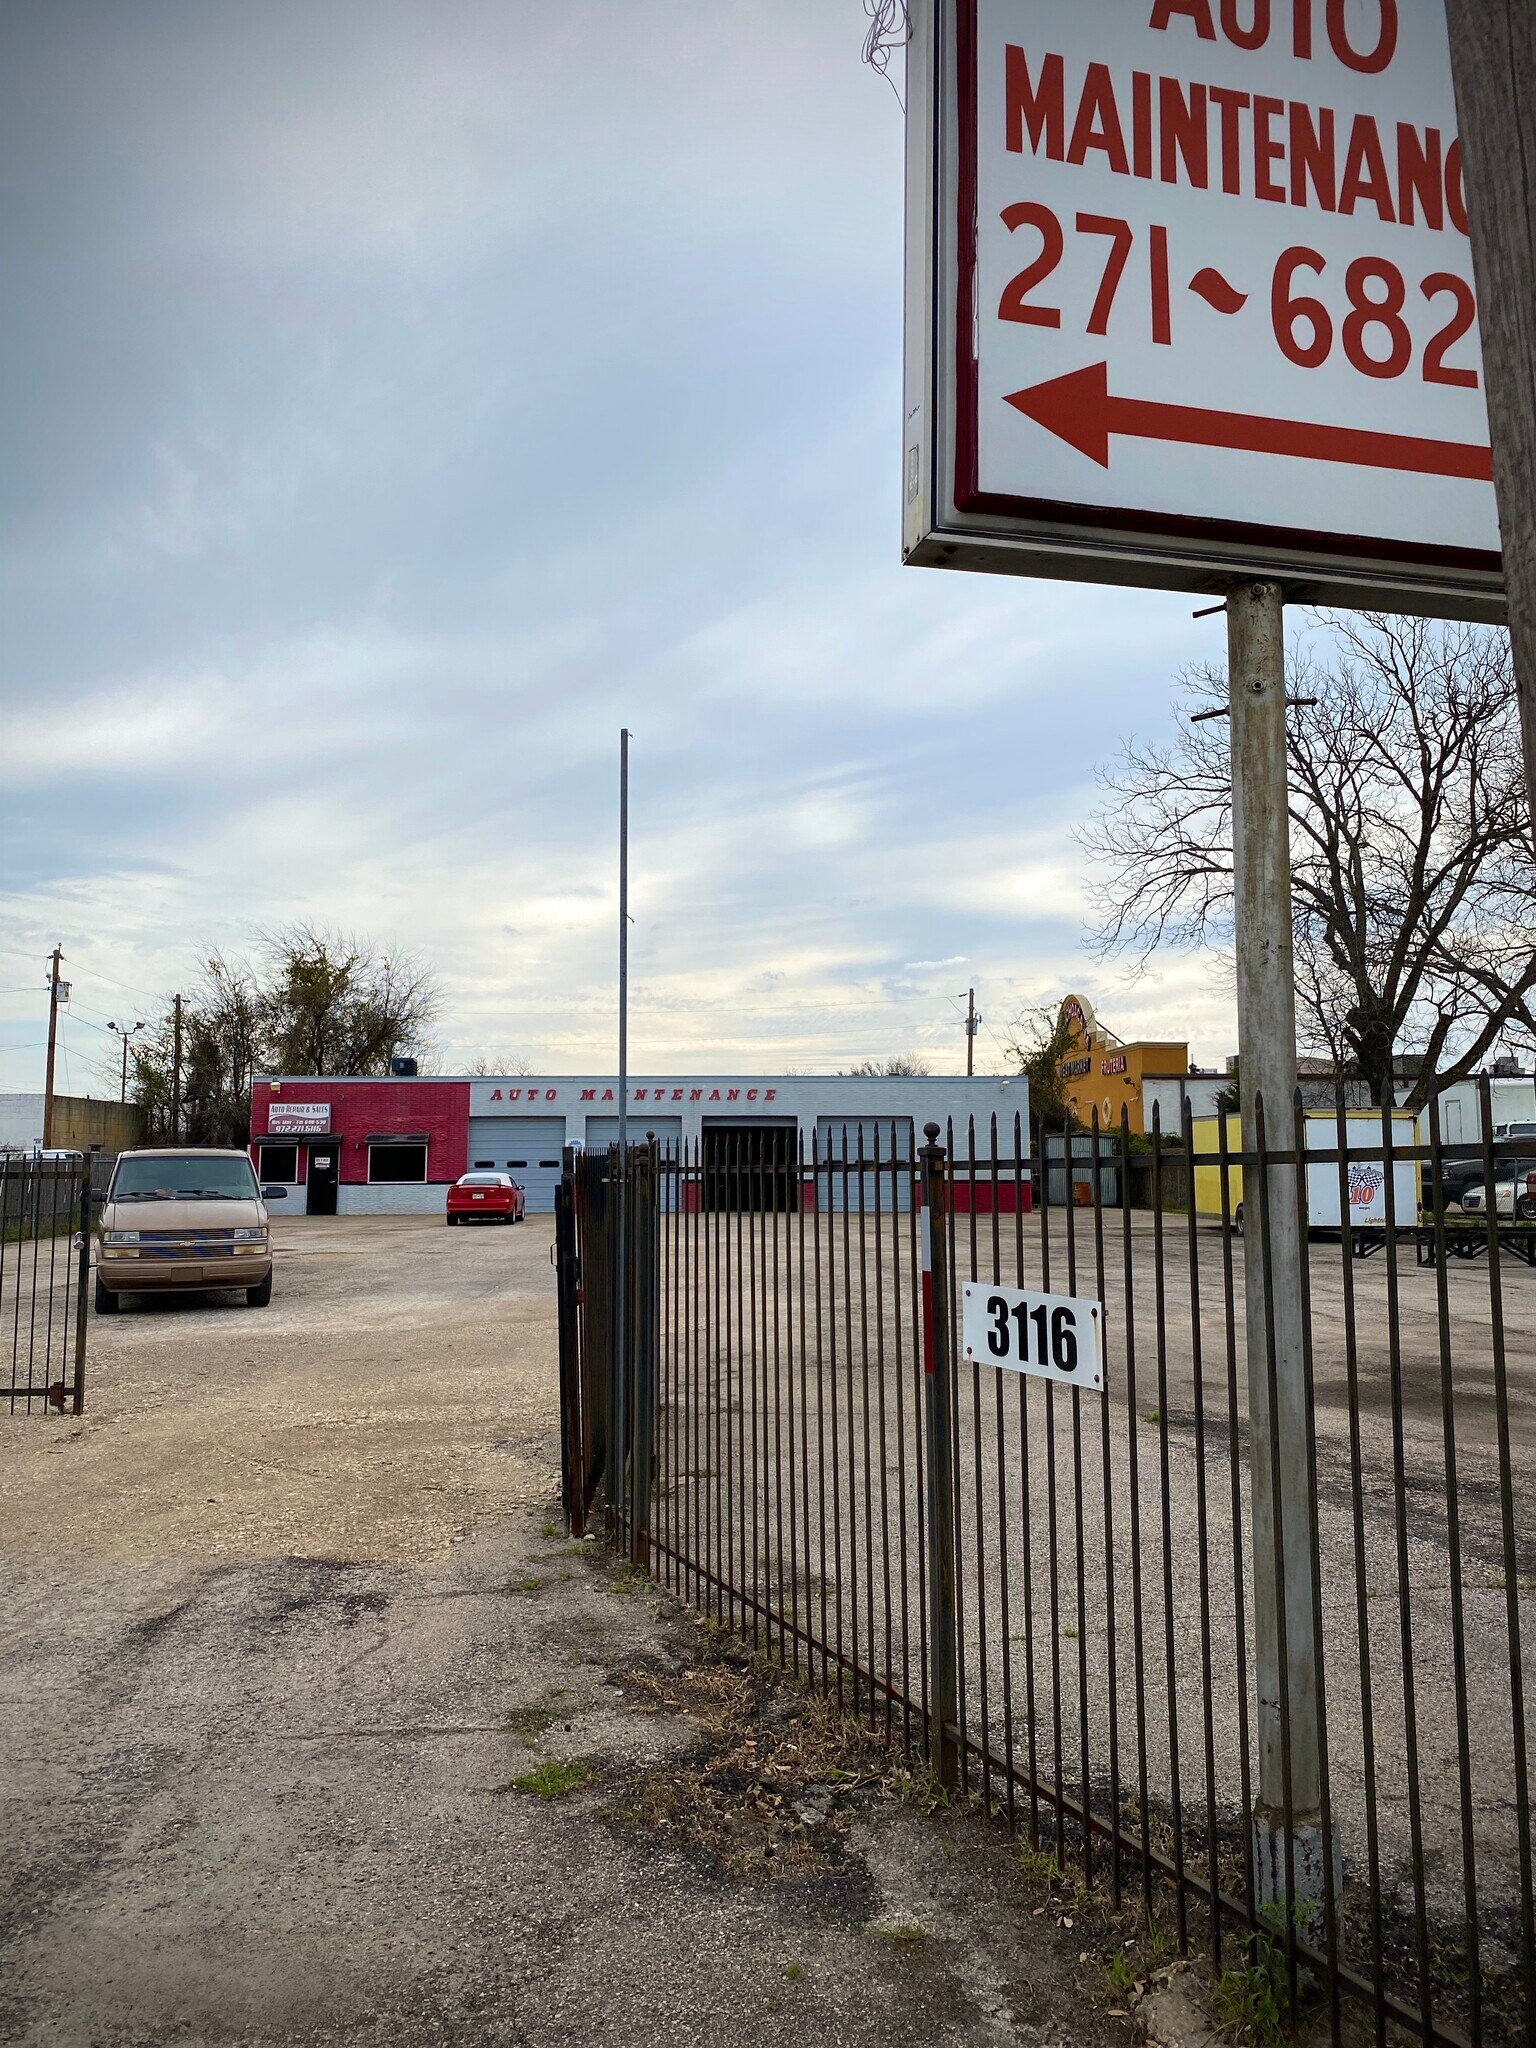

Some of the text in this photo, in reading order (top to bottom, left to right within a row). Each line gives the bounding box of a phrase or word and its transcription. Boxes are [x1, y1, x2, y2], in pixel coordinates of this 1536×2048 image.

[1101, 1056, 1125, 1075] FRUTERIA
[490, 1089, 777, 1101] AUTO MANTENANCE
[1349, 1185, 1374, 1204] 10
[987, 1295, 1078, 1372] 3116
